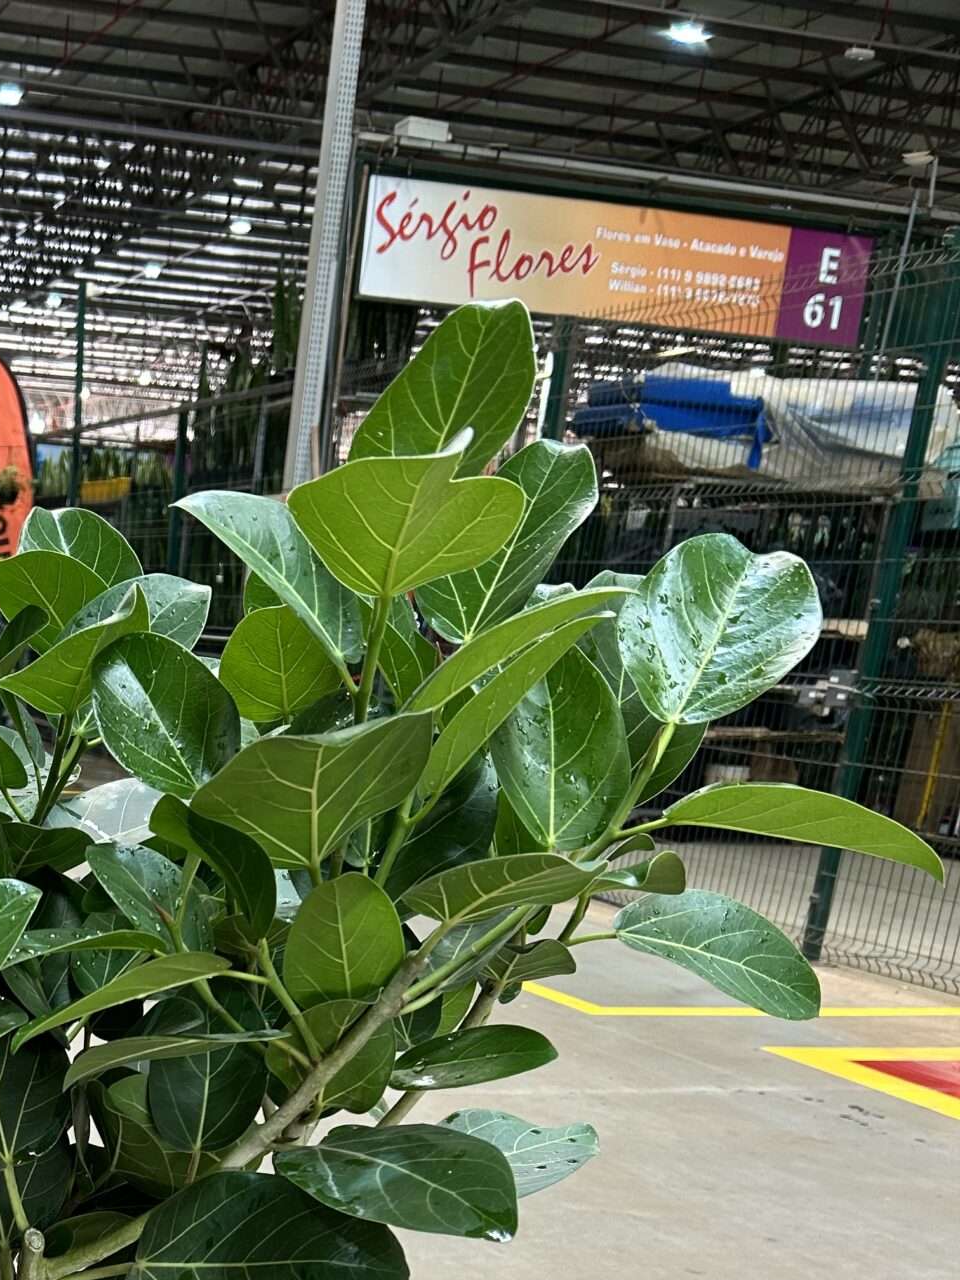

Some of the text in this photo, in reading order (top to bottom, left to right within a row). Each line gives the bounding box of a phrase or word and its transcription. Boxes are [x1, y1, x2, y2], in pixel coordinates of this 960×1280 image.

[376, 190, 497, 260] Sérgio
[467, 228, 599, 298] Flores
[596, 227, 631, 242] Flores
[634, 234, 650, 244] em
[655, 234, 680, 248] Vaso
[691, 238, 736, 255] Atacado
[739, 246, 747, 257] e
[749, 246, 784, 263] Varejo
[657, 266, 681, 282] (11)
[684, 270, 692, 283] 9
[819, 247, 841, 284] E
[803, 293, 843, 330] 61
